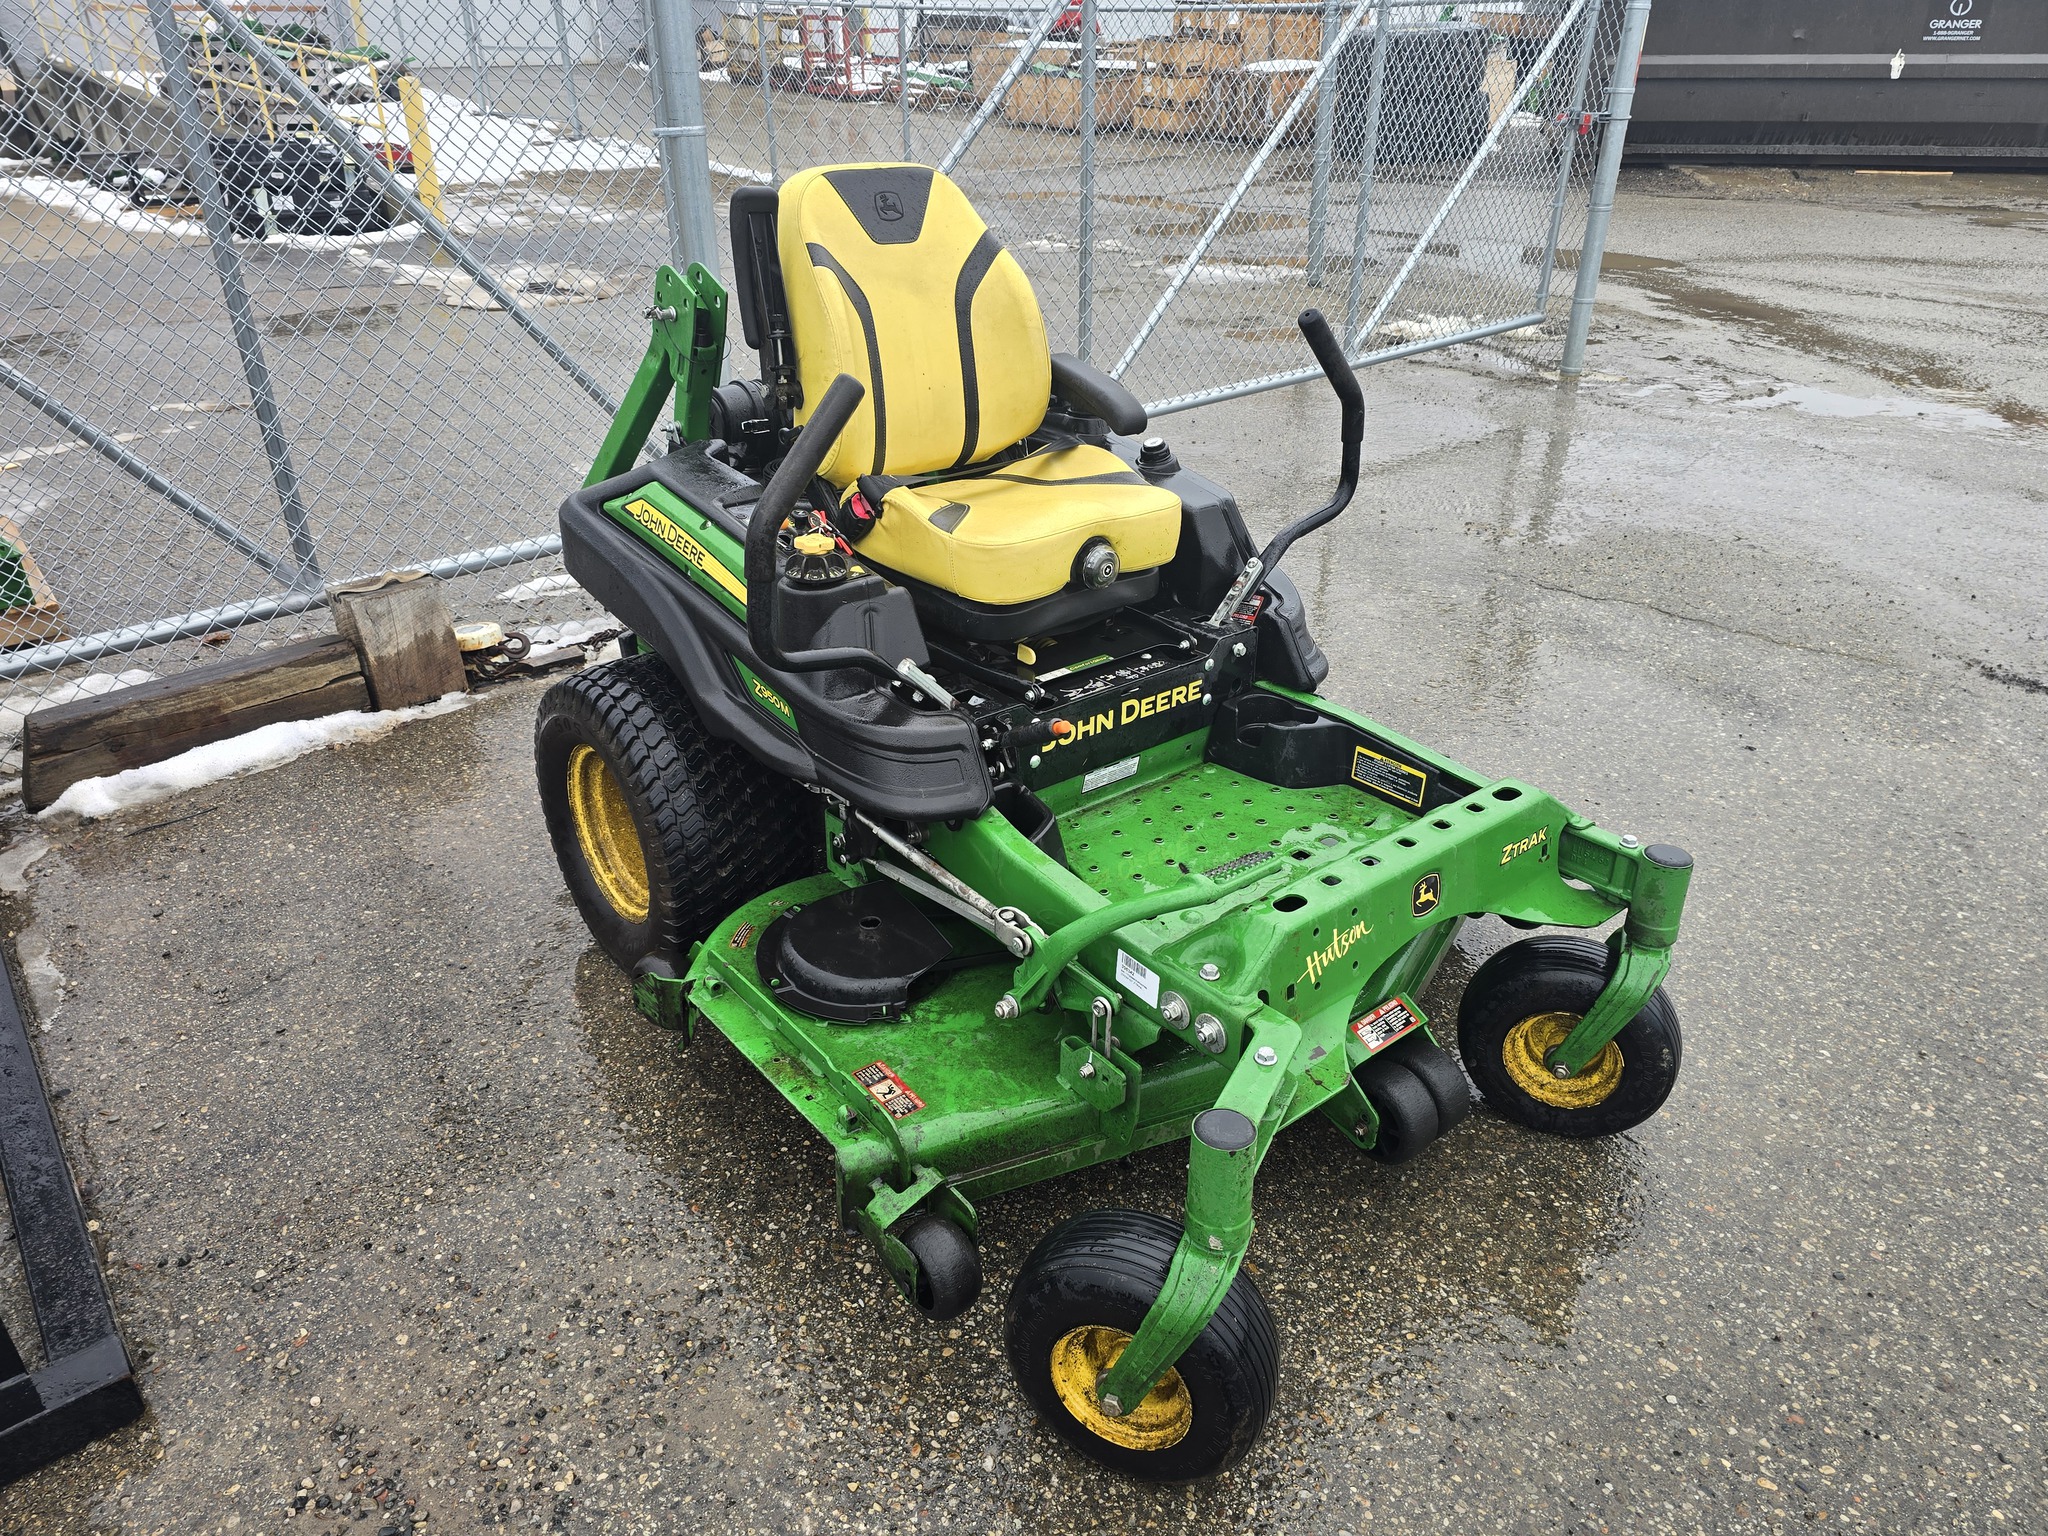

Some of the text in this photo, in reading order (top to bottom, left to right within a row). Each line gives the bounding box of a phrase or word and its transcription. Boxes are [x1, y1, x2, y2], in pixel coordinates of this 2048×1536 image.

[1930, 19, 1982, 29] GRANGER
[636, 503, 706, 568] JOHN DEERE
[752, 678, 791, 718] Z950M
[1121, 679, 1203, 726] DEERE
[1500, 825, 1549, 866] ZTRAK
[1297, 920, 1374, 984] Hutson
